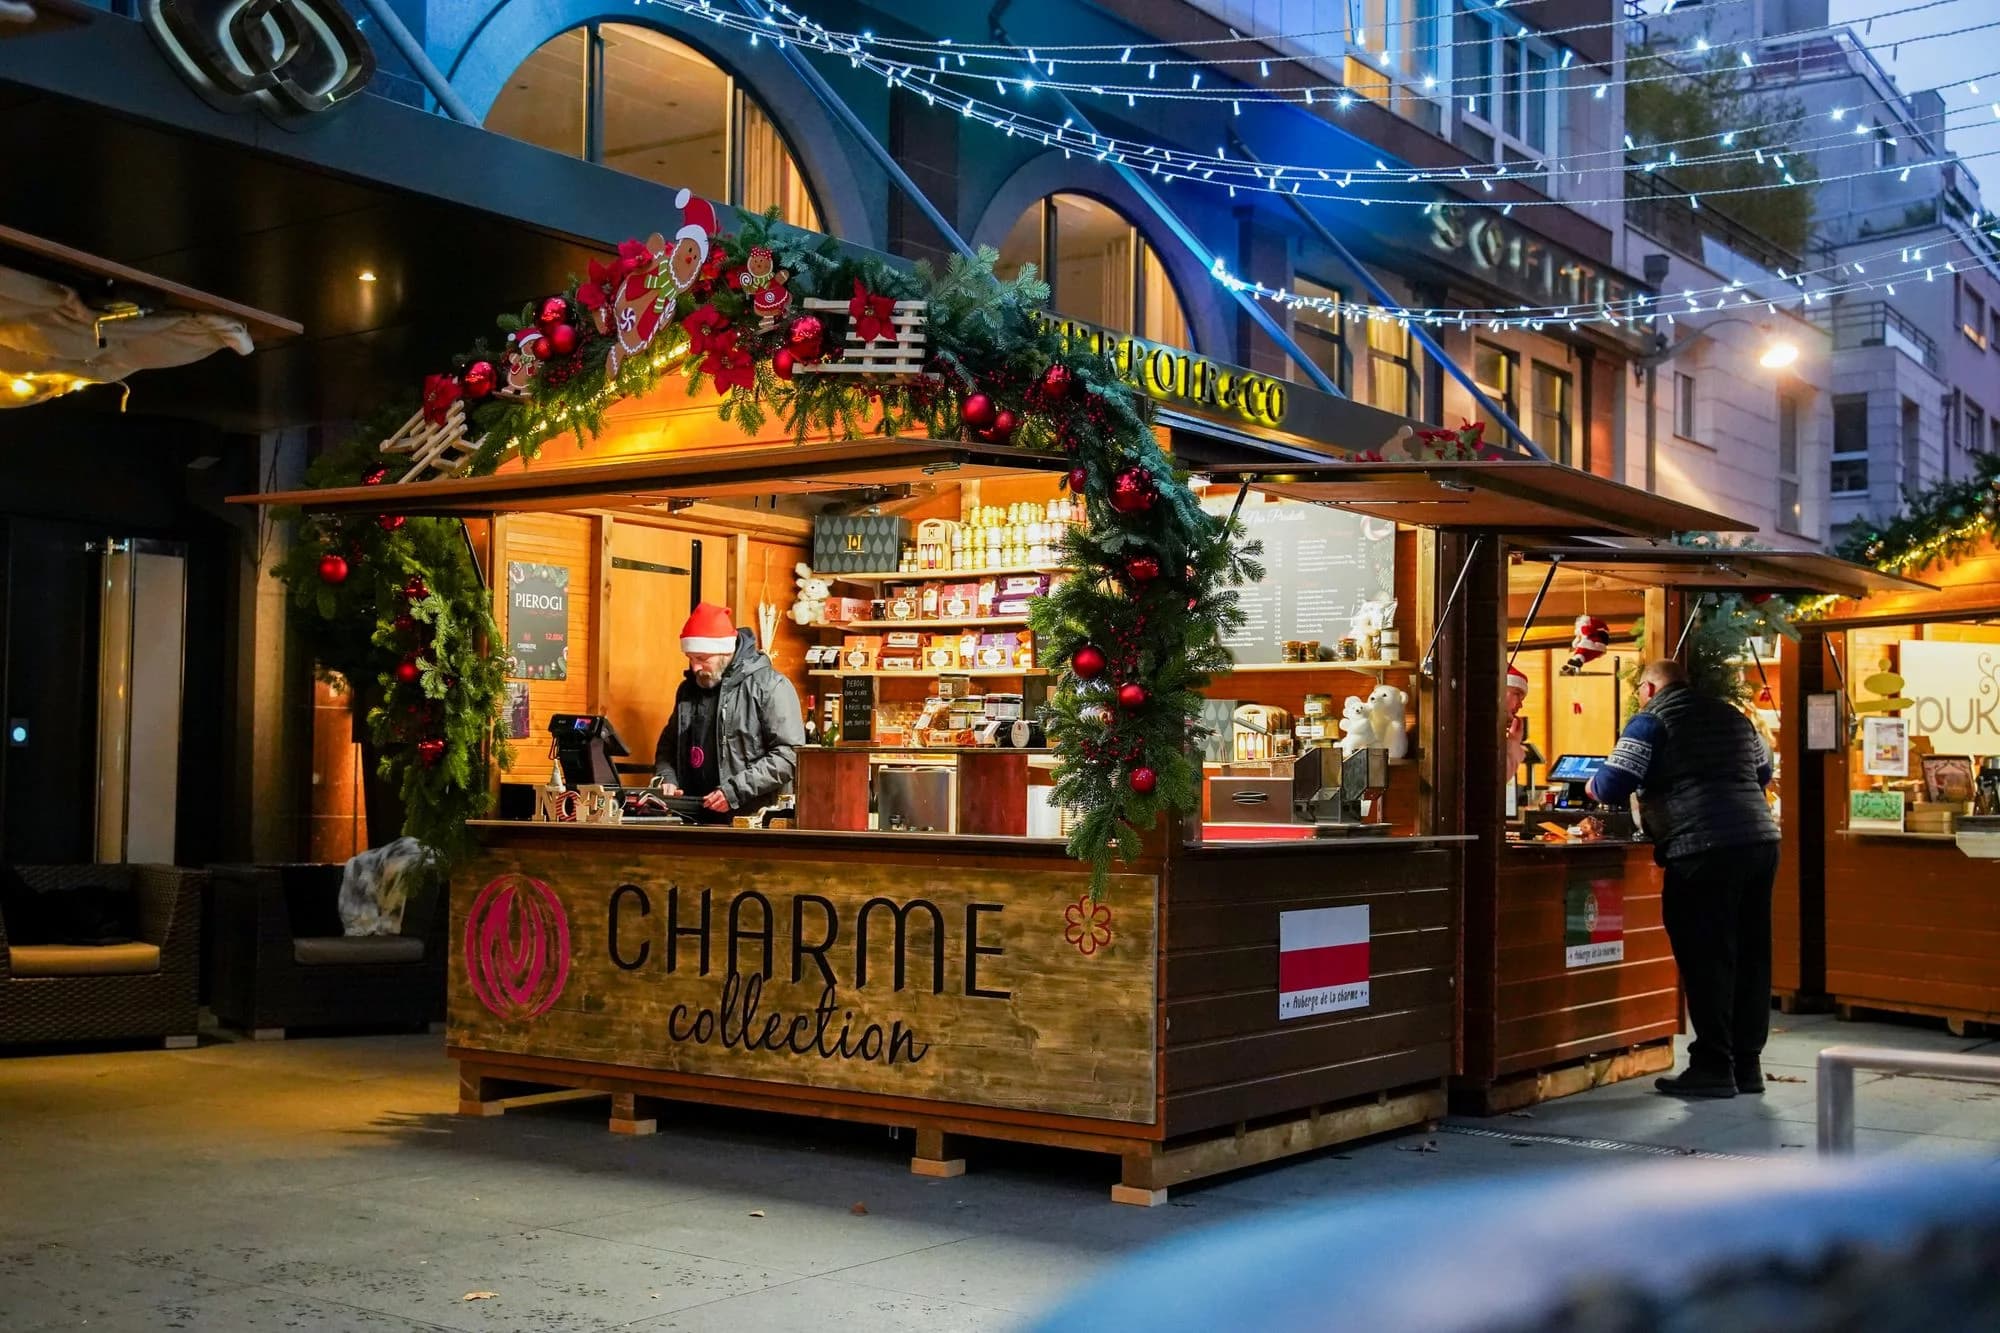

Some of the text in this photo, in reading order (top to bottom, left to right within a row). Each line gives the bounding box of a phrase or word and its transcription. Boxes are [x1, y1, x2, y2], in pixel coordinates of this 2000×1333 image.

[515, 592, 562, 611] PIEROGI
[607, 884, 1012, 1000] CHARME
[668, 972, 928, 1064] collection
[1292, 989, 1359, 1012] Auberge de la charme
